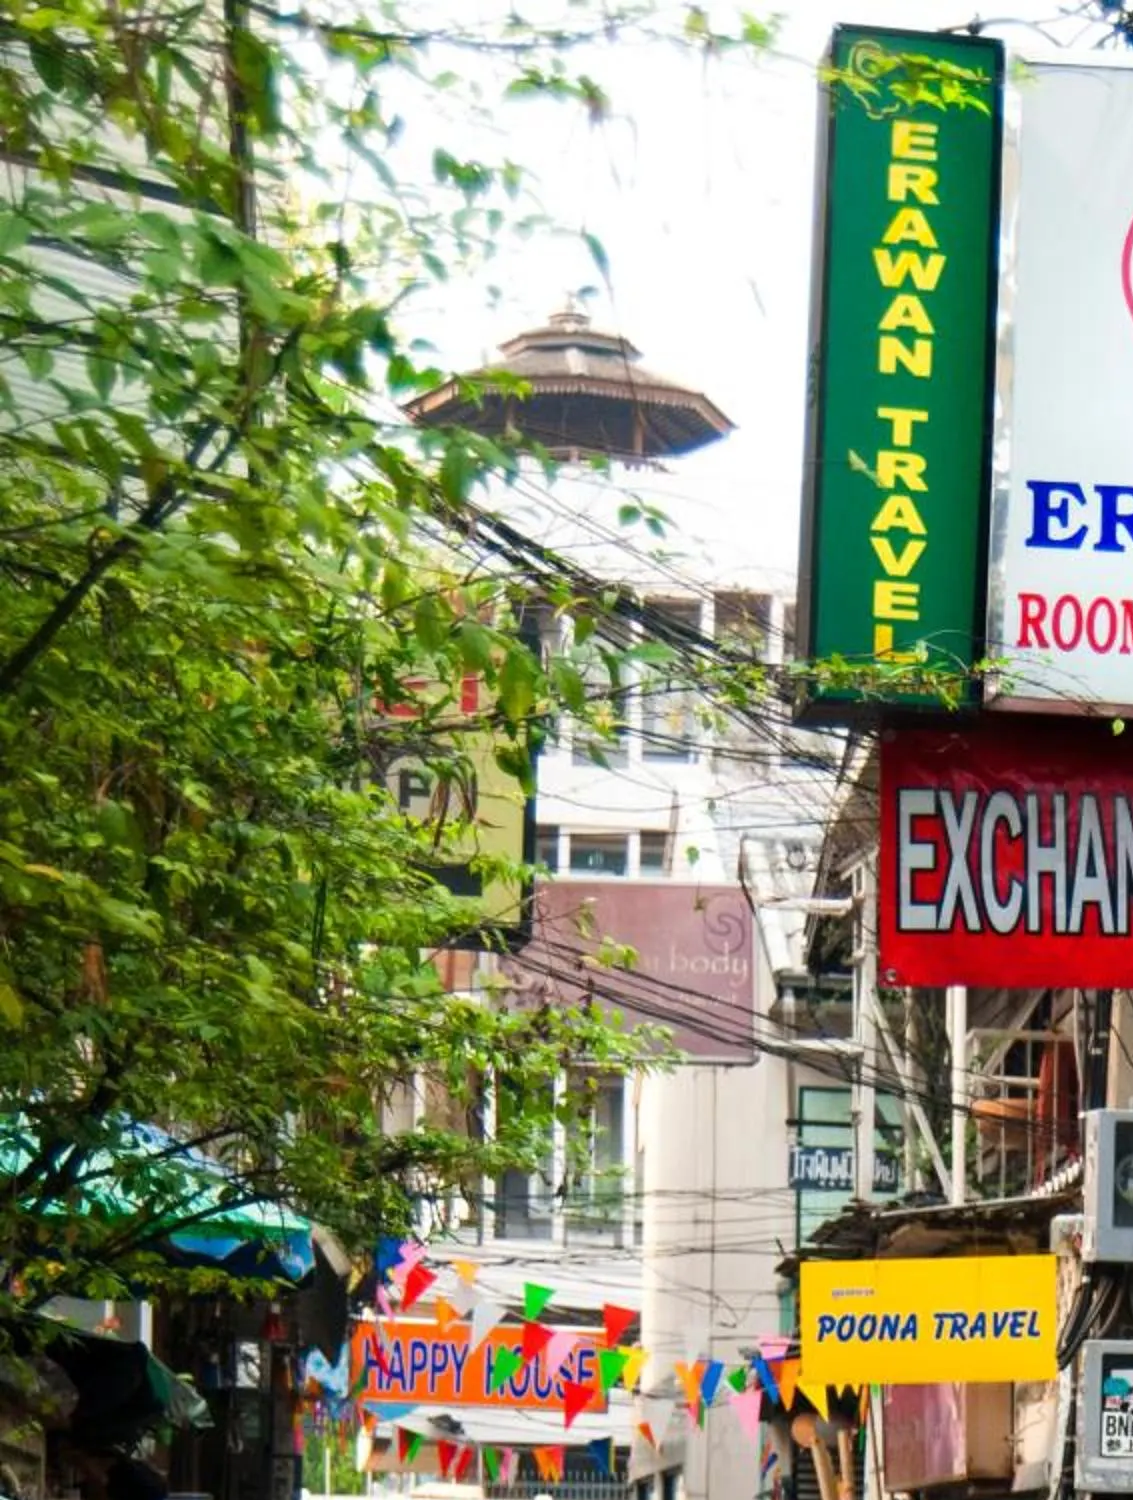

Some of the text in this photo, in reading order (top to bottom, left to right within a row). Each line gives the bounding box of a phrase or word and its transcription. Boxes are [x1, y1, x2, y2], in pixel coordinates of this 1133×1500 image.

[872, 121, 946, 378] ERAWAN
[868, 407, 930, 664] TRAVEL
[669, 940, 750, 988] body
[817, 1310, 1042, 1343] POONA TRAVEL
[364, 1338, 469, 1394] HAPPY
